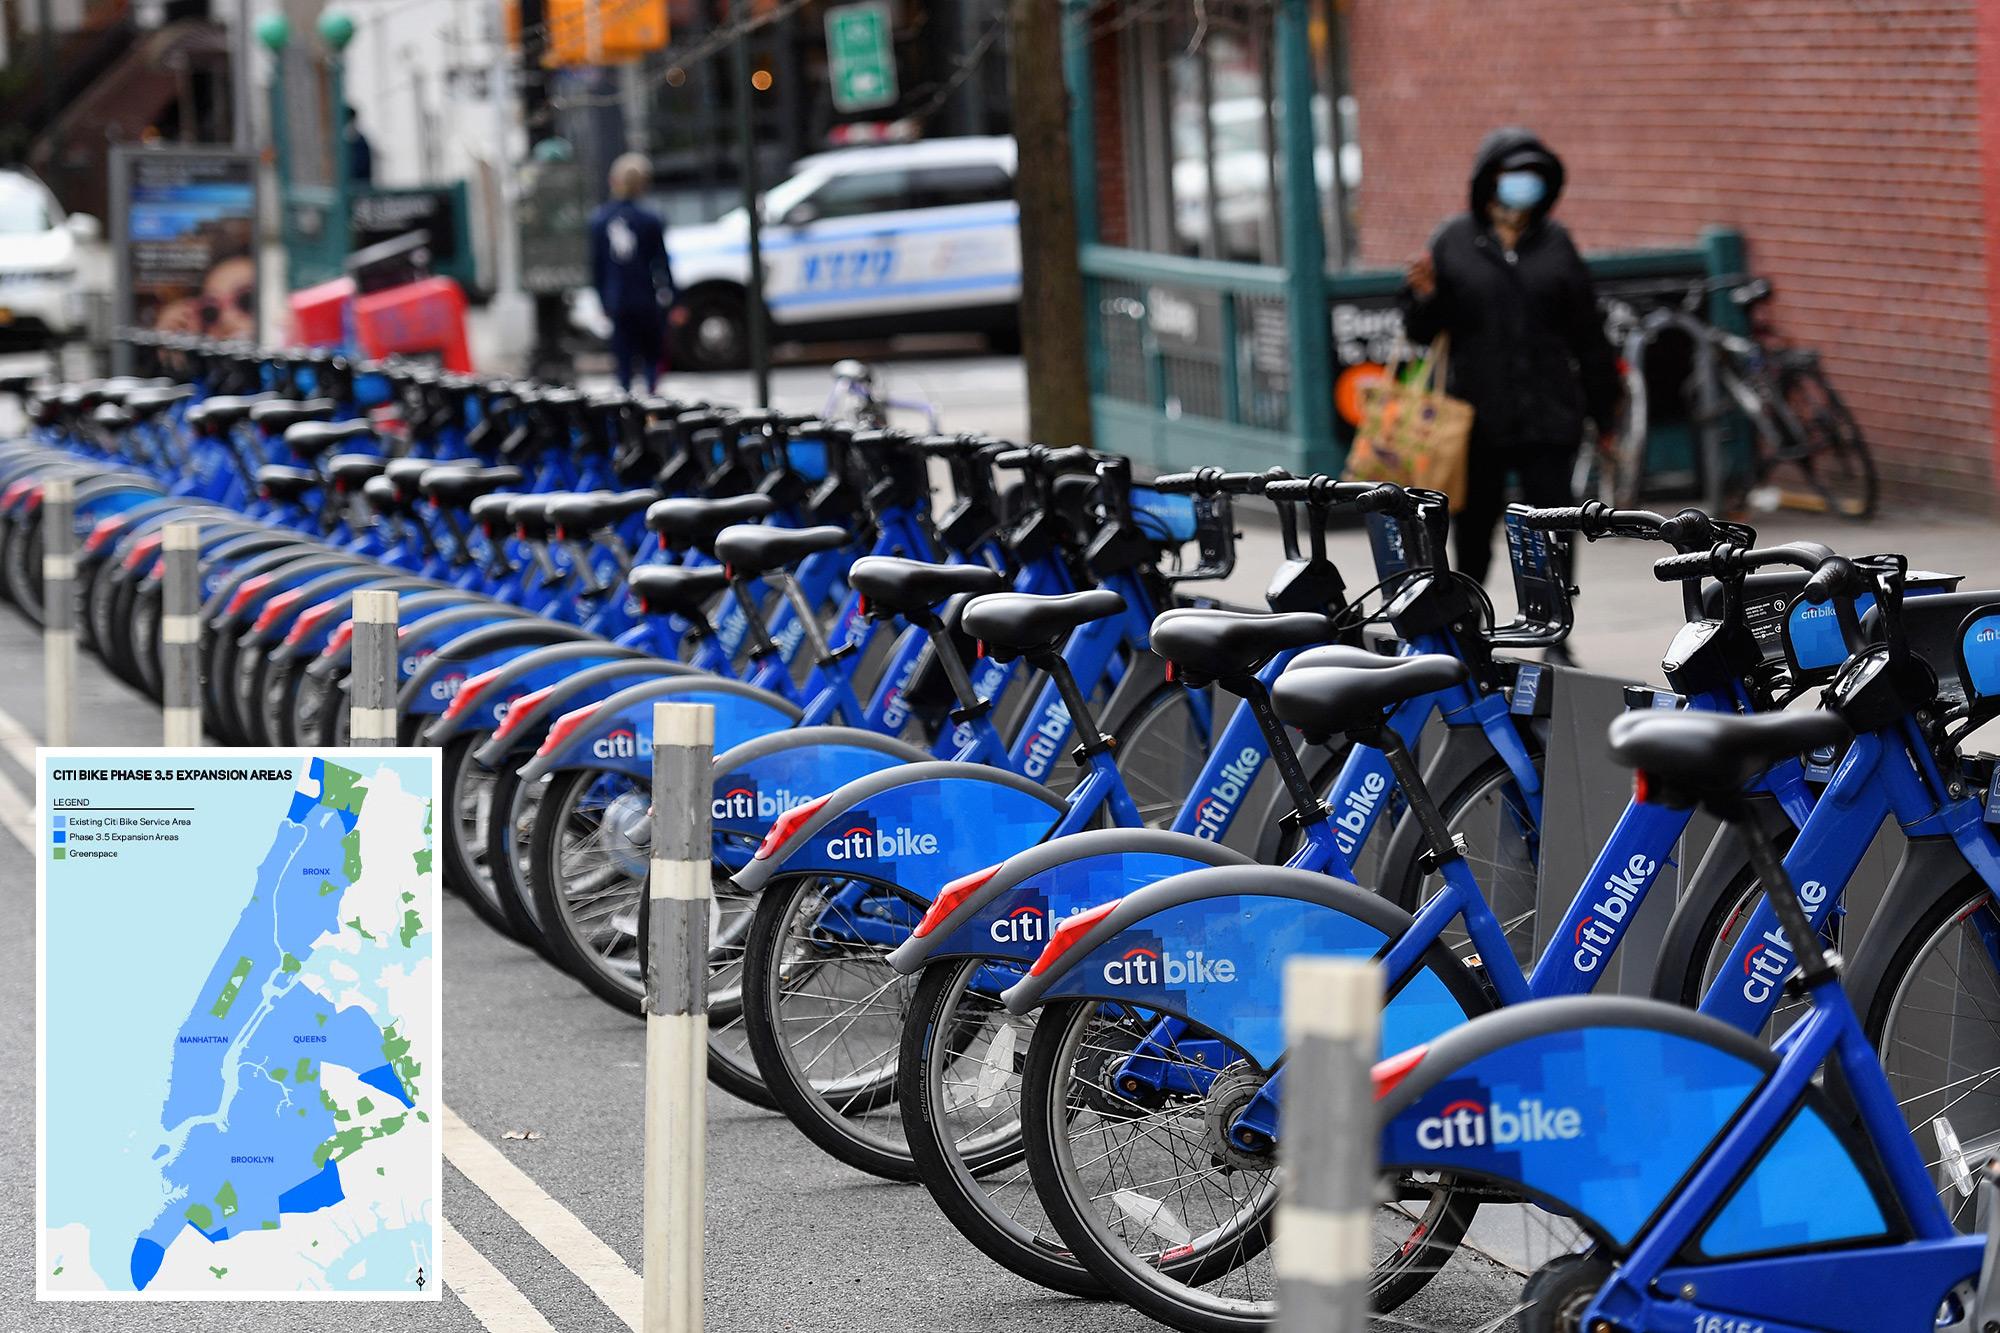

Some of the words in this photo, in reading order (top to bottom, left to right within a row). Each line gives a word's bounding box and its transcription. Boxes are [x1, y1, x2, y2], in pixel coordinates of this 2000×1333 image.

[1801, 607, 1817, 620] citi
[1976, 628, 1994, 643] citi
[1037, 697, 1072, 741] bik
[593, 729, 635, 759] citi
[1023, 732, 1057, 778] citi
[1210, 746, 1261, 805] bike
[712, 788, 754, 819] citi
[757, 788, 814, 818] bik
[1194, 797, 1231, 842] citi
[1336, 772, 1385, 835] bike
[826, 827, 873, 860] citi
[877, 827, 938, 858] bike
[1593, 854, 1656, 924] bike
[990, 906, 1043, 942] citi
[1573, 916, 1615, 973] citi
[1103, 948, 1158, 985] citi
[1164, 950, 1236, 984] bike
[1743, 944, 1789, 1004] citi
[919, 1062, 931, 1123] SCHWALBE
[1416, 1099, 1486, 1150] citi
[1490, 1099, 1582, 1144] bike
